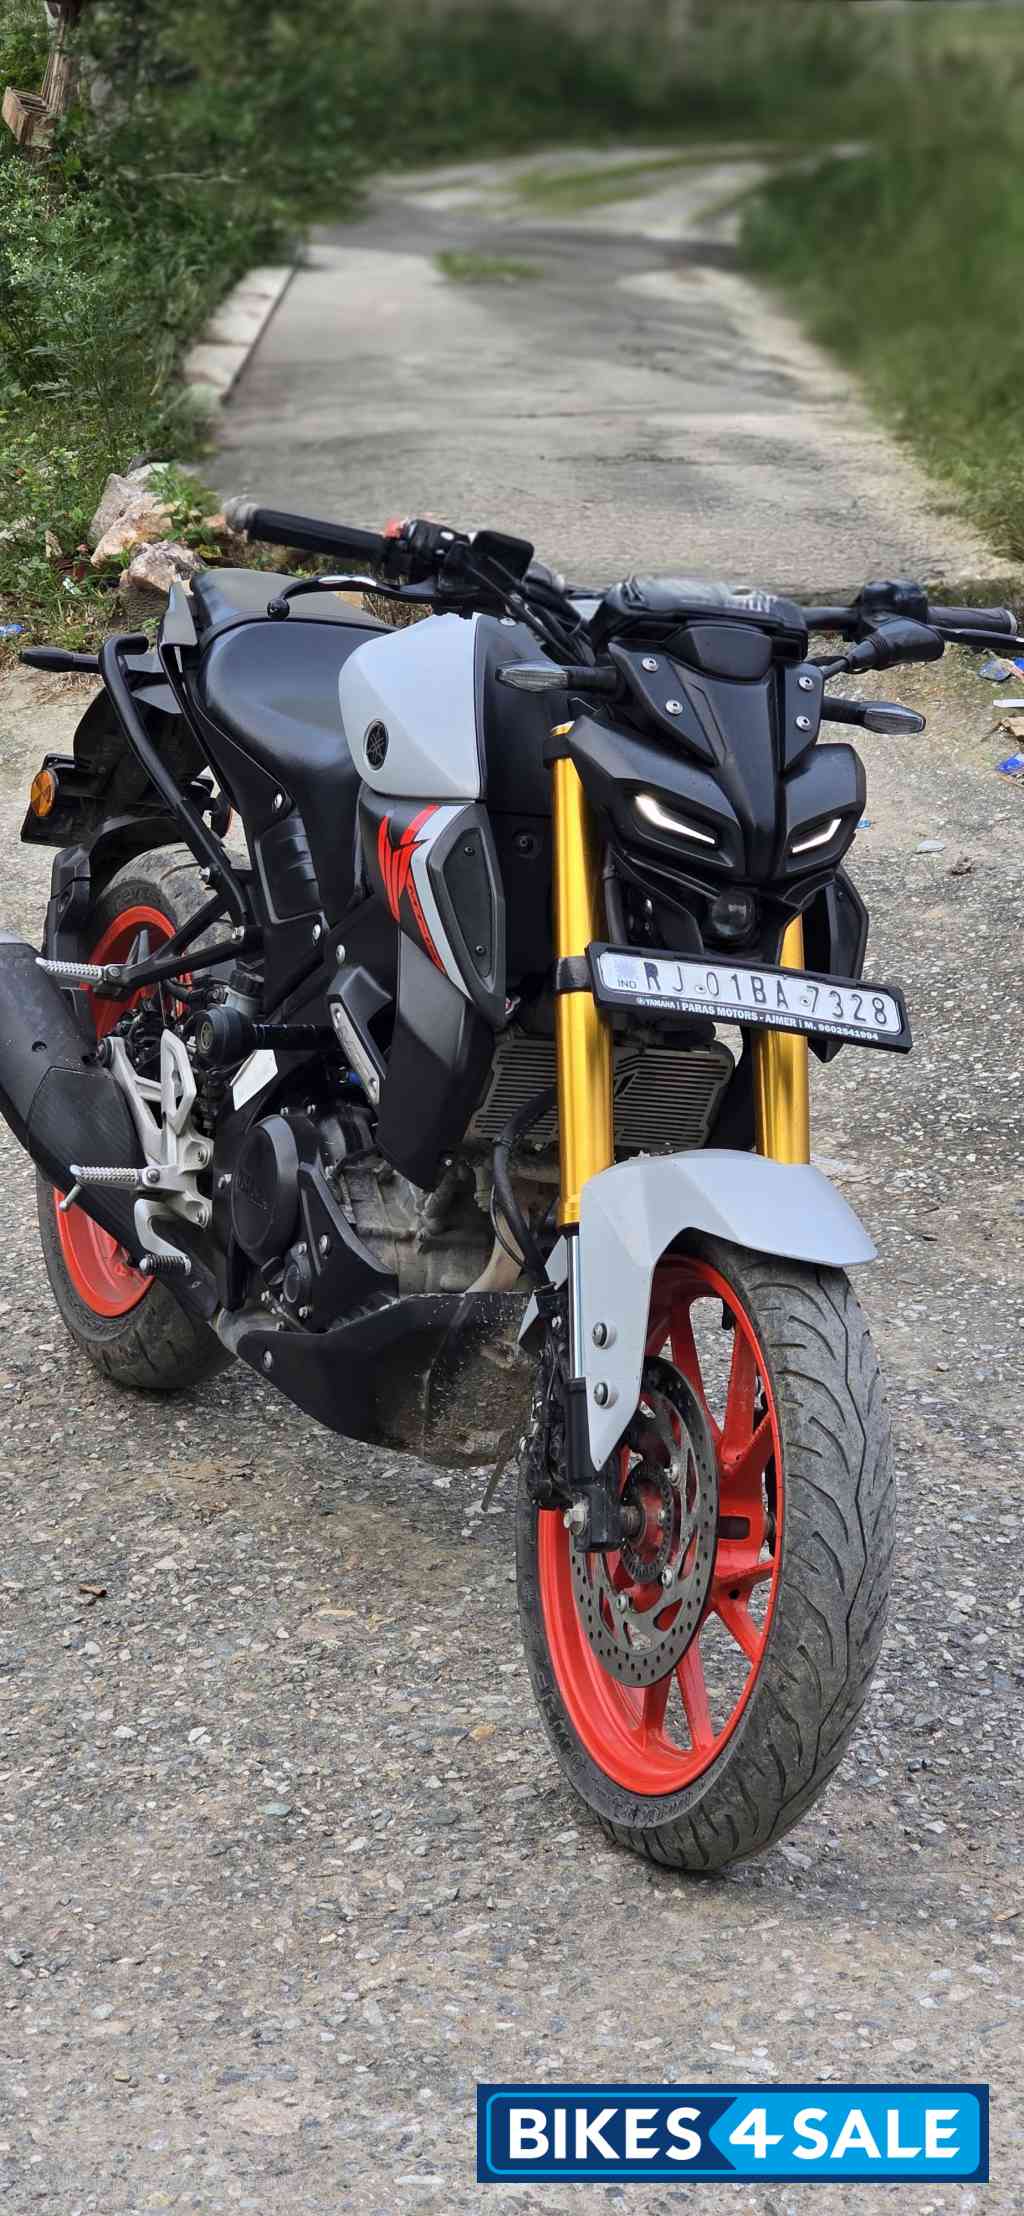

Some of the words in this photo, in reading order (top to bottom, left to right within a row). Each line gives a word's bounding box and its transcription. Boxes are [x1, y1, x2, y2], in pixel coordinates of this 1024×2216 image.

[616, 978, 638, 990] IND
[643, 961, 684, 992] RJ
[706, 971, 789, 1009] 01BA
[806, 985, 887, 1025] 7328
[682, 1002, 715, 1016] PARAS
[716, 1007, 759, 1021] MOTORS
[764, 1014, 798, 1028] AJMER
